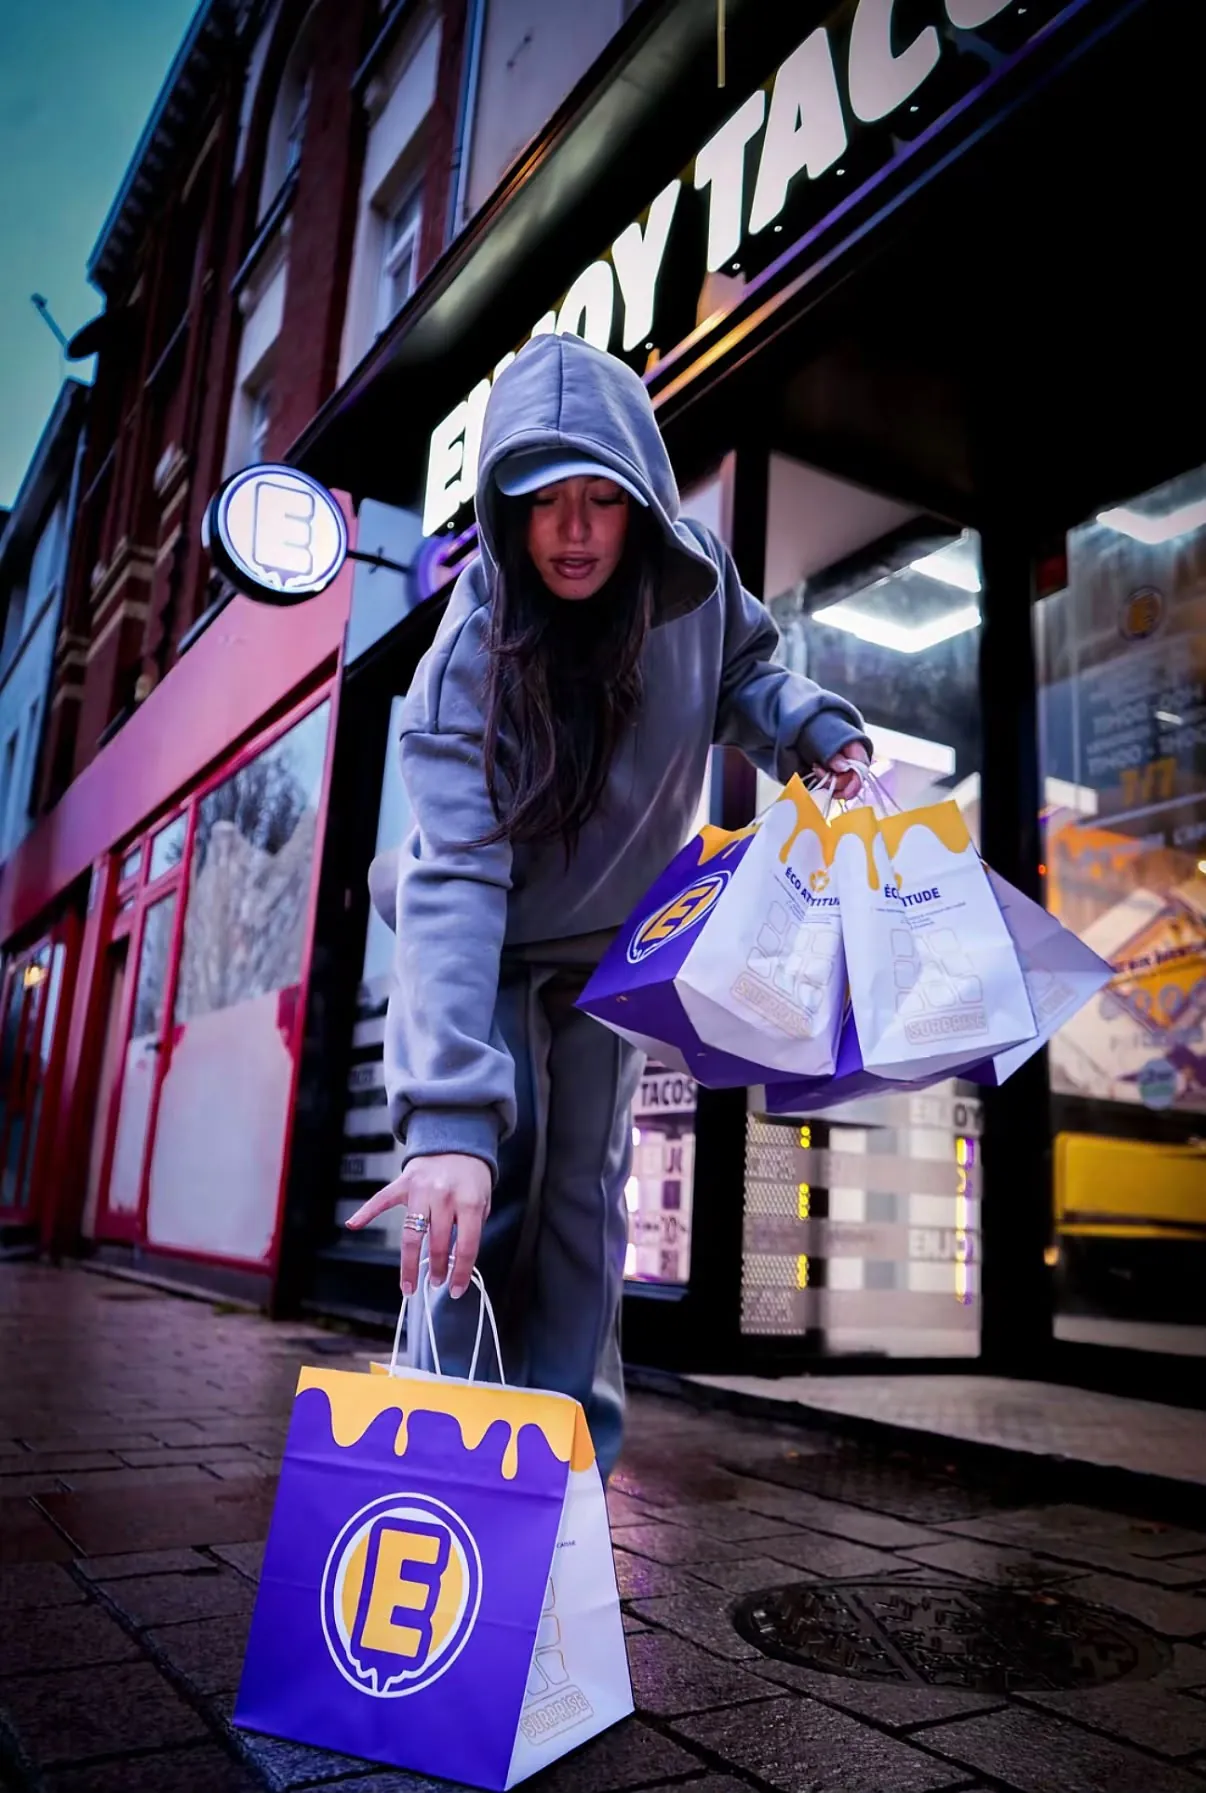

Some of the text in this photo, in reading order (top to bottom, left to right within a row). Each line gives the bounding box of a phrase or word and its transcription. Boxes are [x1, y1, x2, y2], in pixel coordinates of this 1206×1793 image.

[694, 0, 1012, 273] TAC
[253, 481, 316, 576] E
[641, 884, 715, 943] E
[641, 1079, 696, 1107] TACOS
[359, 1526, 443, 1660] E
[520, 1690, 589, 1740] SURPRISE
